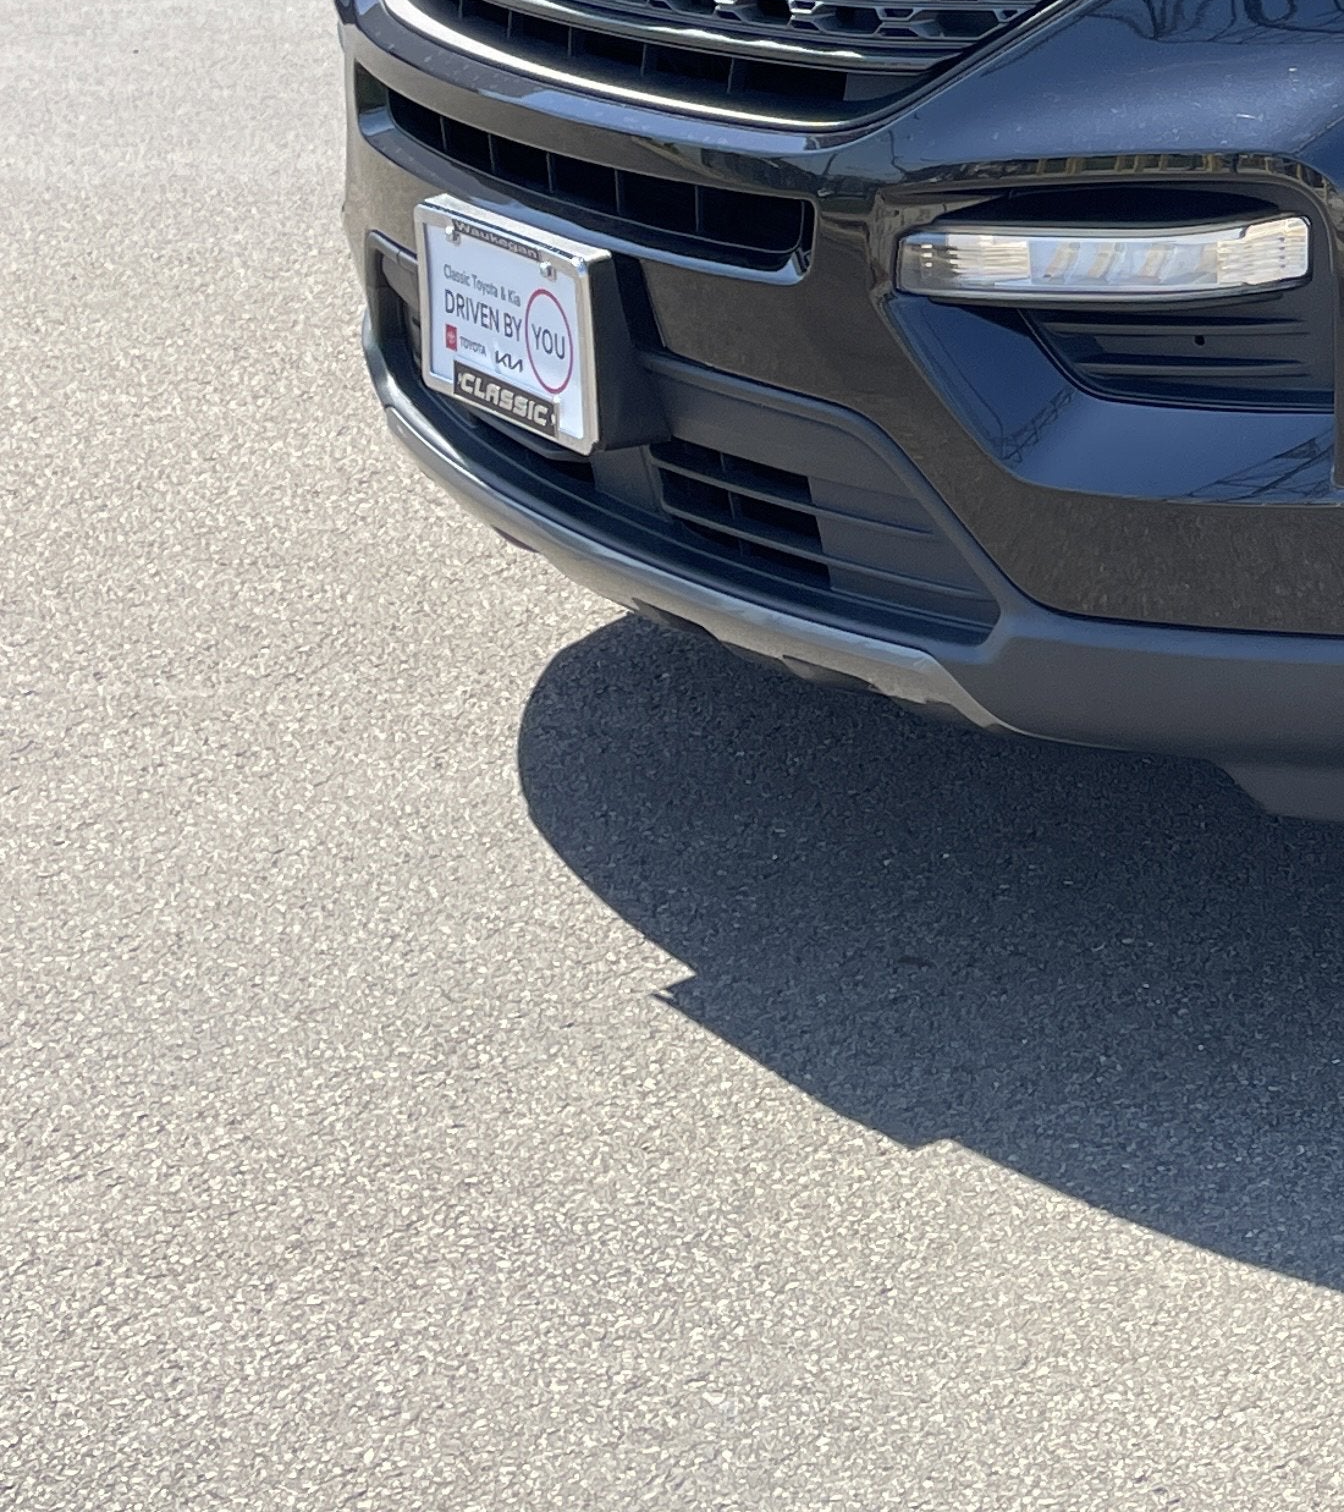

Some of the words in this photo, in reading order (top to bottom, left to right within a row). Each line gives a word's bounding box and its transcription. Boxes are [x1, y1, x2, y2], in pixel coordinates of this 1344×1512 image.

[455, 220, 540, 260] Waukegan
[443, 263, 471, 287] Classic
[471, 274, 499, 298] Toyota
[500, 286, 506, 301] &
[507, 289, 522, 307] Kia
[444, 289, 500, 333] DRIVEN
[503, 312, 522, 342] BY
[531, 323, 565, 360] YOU
[459, 335, 487, 356] TOYOTA
[460, 372, 549, 426] CLASSIC
